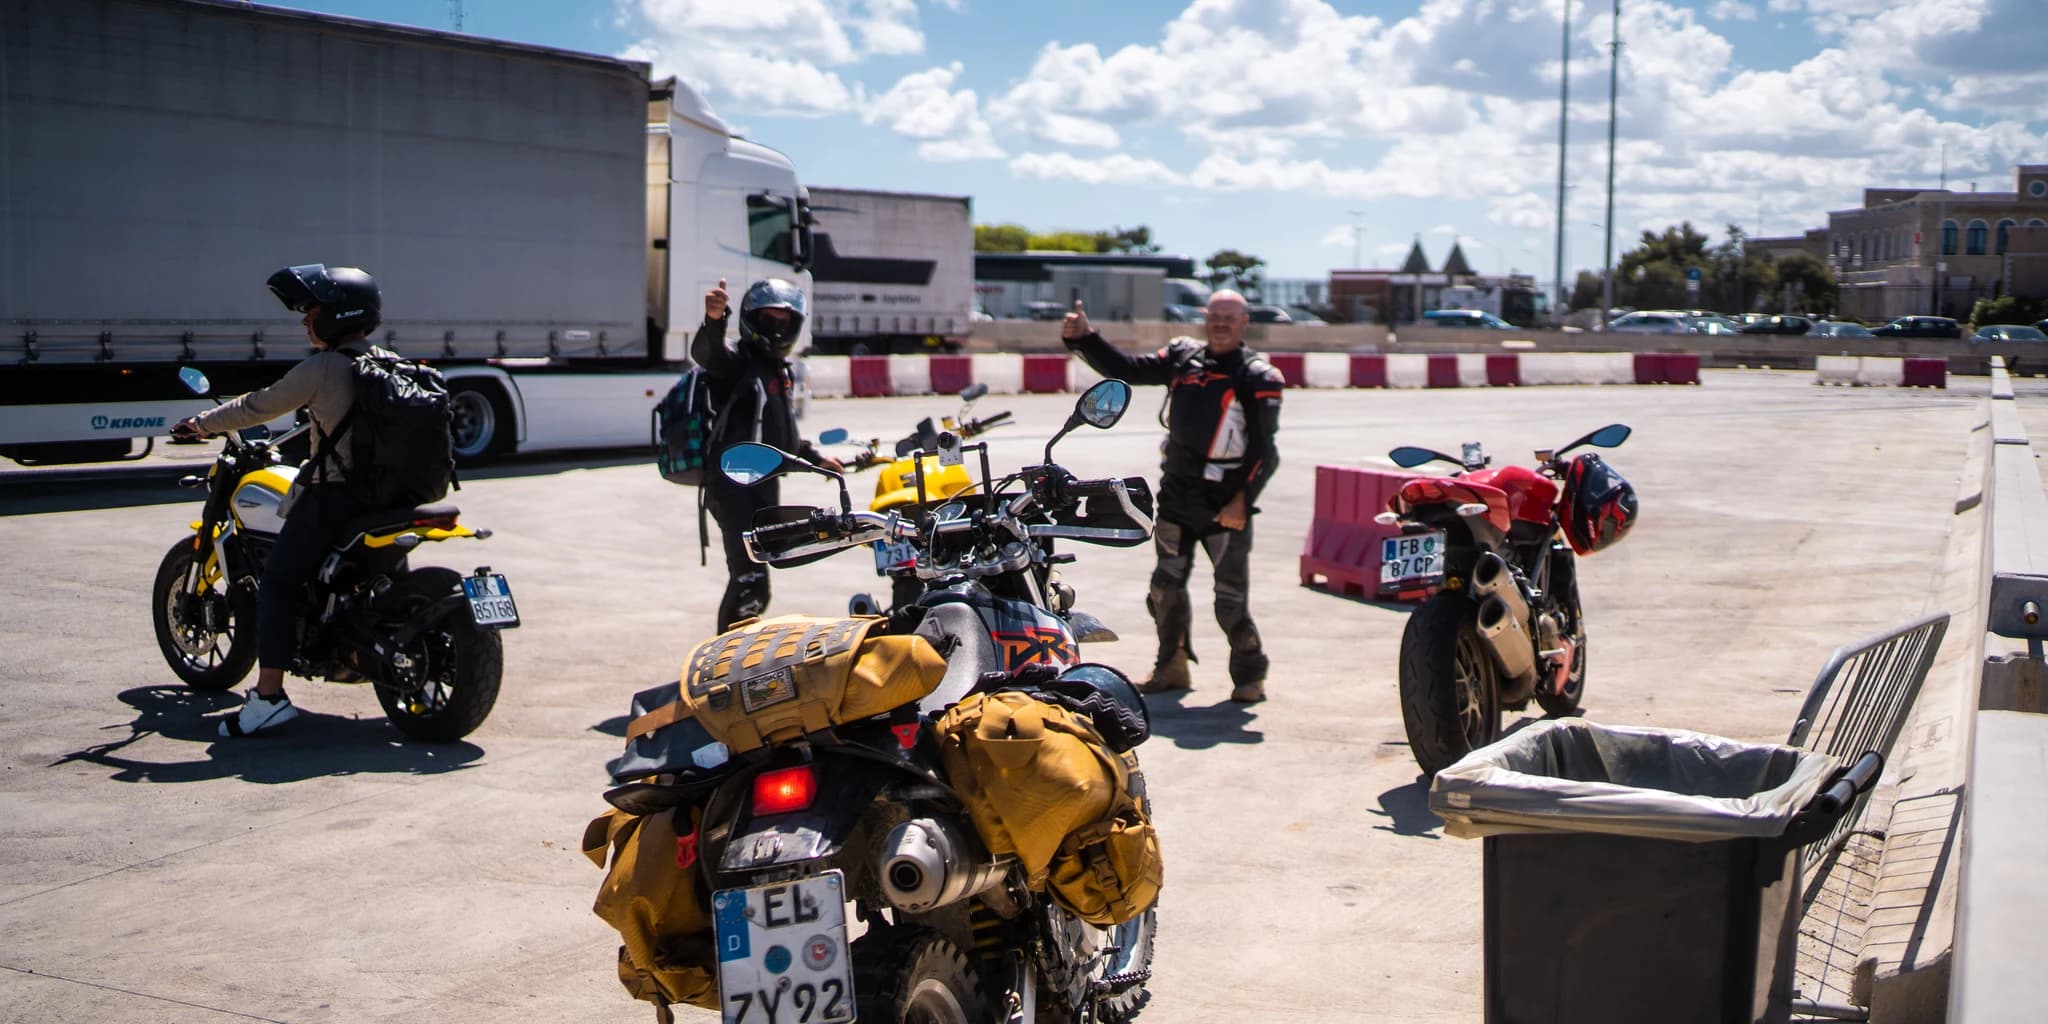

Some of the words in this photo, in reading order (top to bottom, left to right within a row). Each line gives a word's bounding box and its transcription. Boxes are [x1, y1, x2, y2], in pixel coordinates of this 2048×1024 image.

[109, 416, 166, 429] KRONE
[1399, 538, 1419, 557] FB
[1391, 559, 1410, 578] 87
[1414, 556, 1434, 575] CP
[474, 600, 514, 620] 85168
[995, 628, 1074, 676] DR
[764, 884, 819, 927] EL
[727, 934, 741, 952] D
